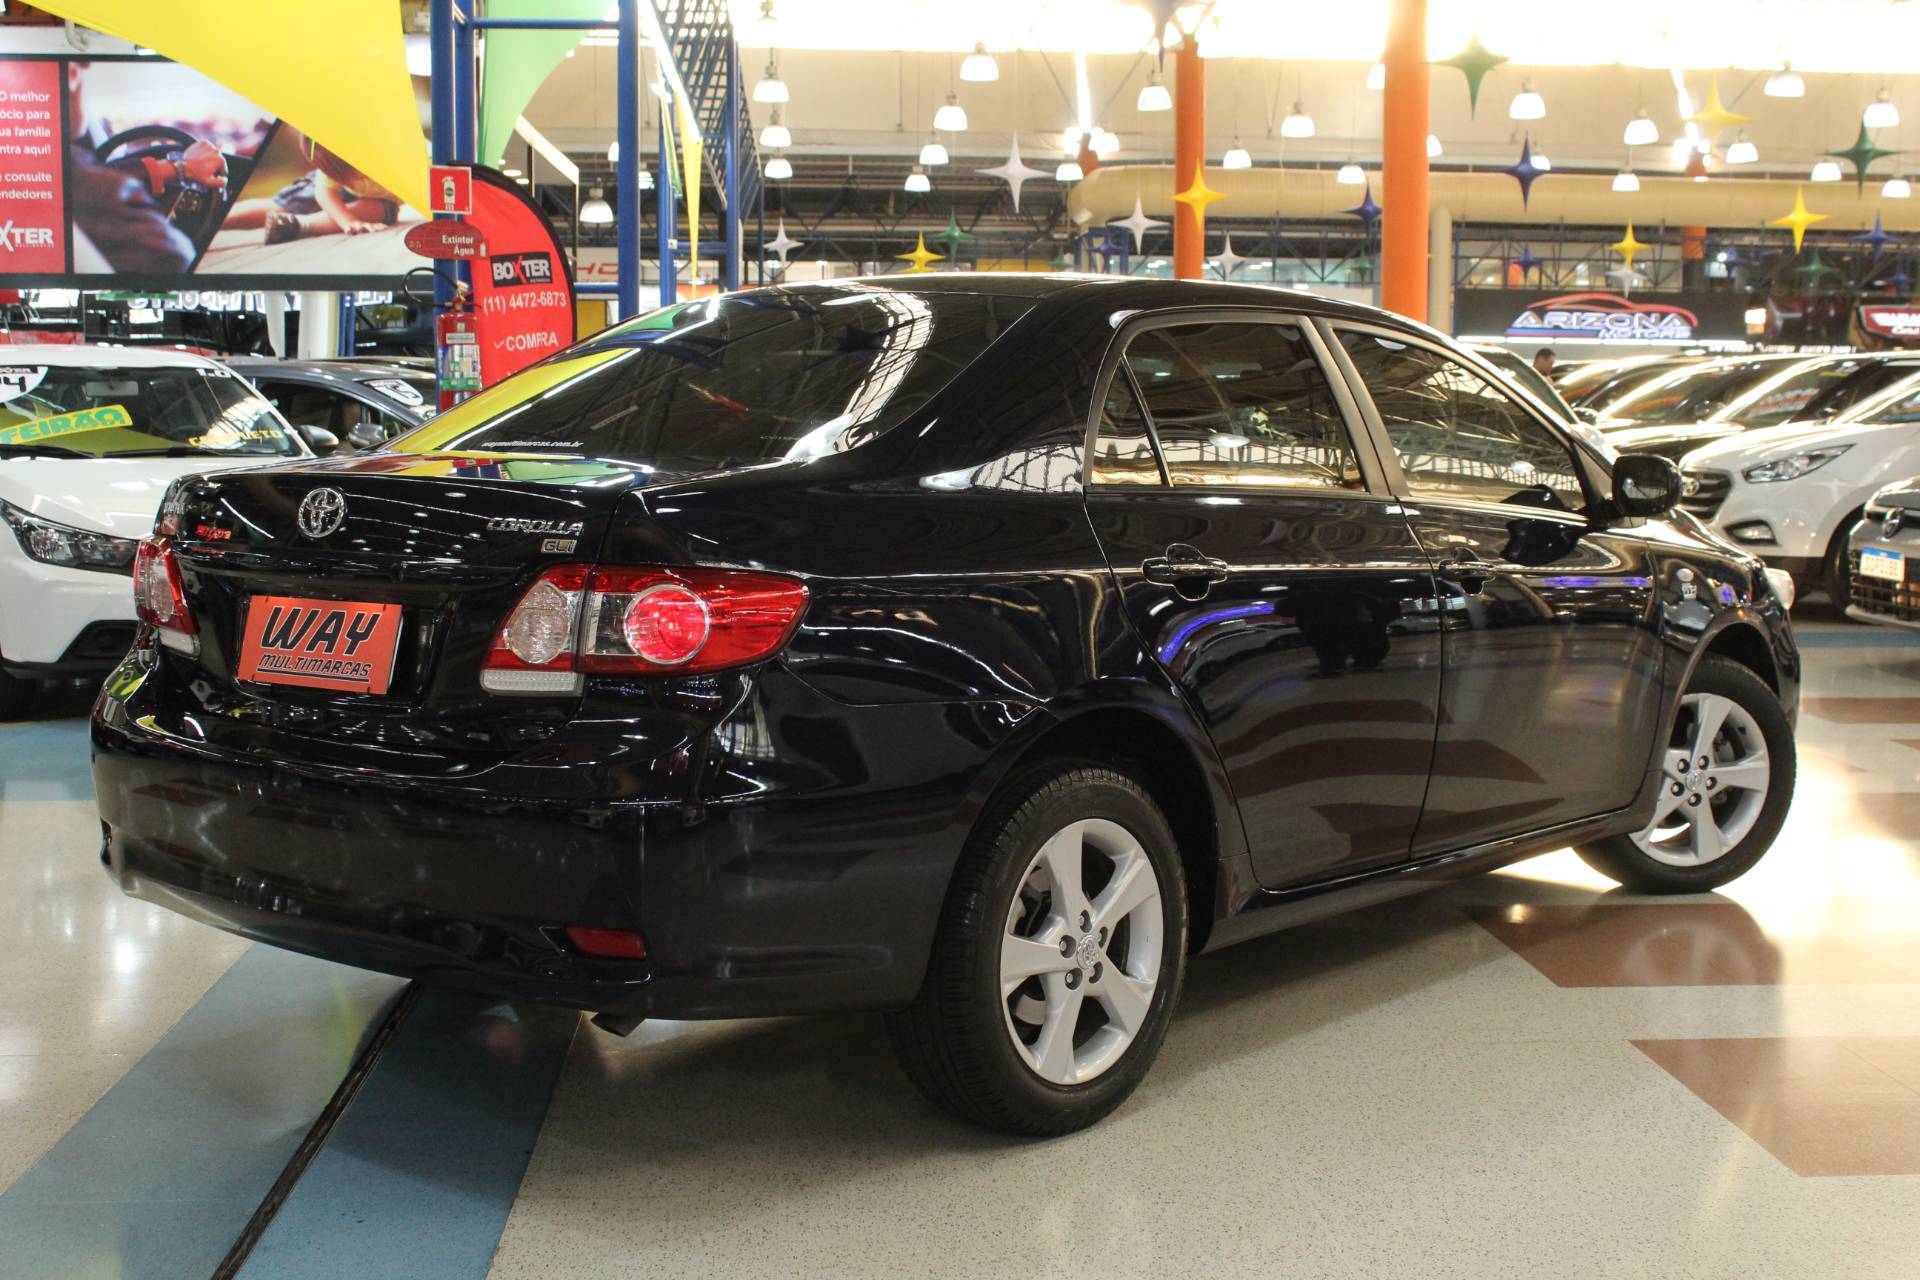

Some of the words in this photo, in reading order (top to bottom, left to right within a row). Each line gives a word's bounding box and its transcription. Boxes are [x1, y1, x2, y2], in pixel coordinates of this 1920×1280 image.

[10, 91, 50, 102] melhor
[26, 111, 51, 122] para
[24, 144, 51, 157] aqui!
[5, 172, 52, 182] consulte
[442, 234, 474, 244] Extintor
[492, 256, 550, 283] BOXTER
[483, 296, 507, 316] (11)
[509, 291, 567, 309] 4472-6873
[1512, 311, 1692, 329] ARIZONA
[505, 332, 558, 351] COMPRA
[1598, 328, 1692, 340] MOTORS
[486, 517, 584, 537] COROLLA
[260, 605, 383, 657] WAY
[257, 654, 372, 678] MULTIMARCAS
